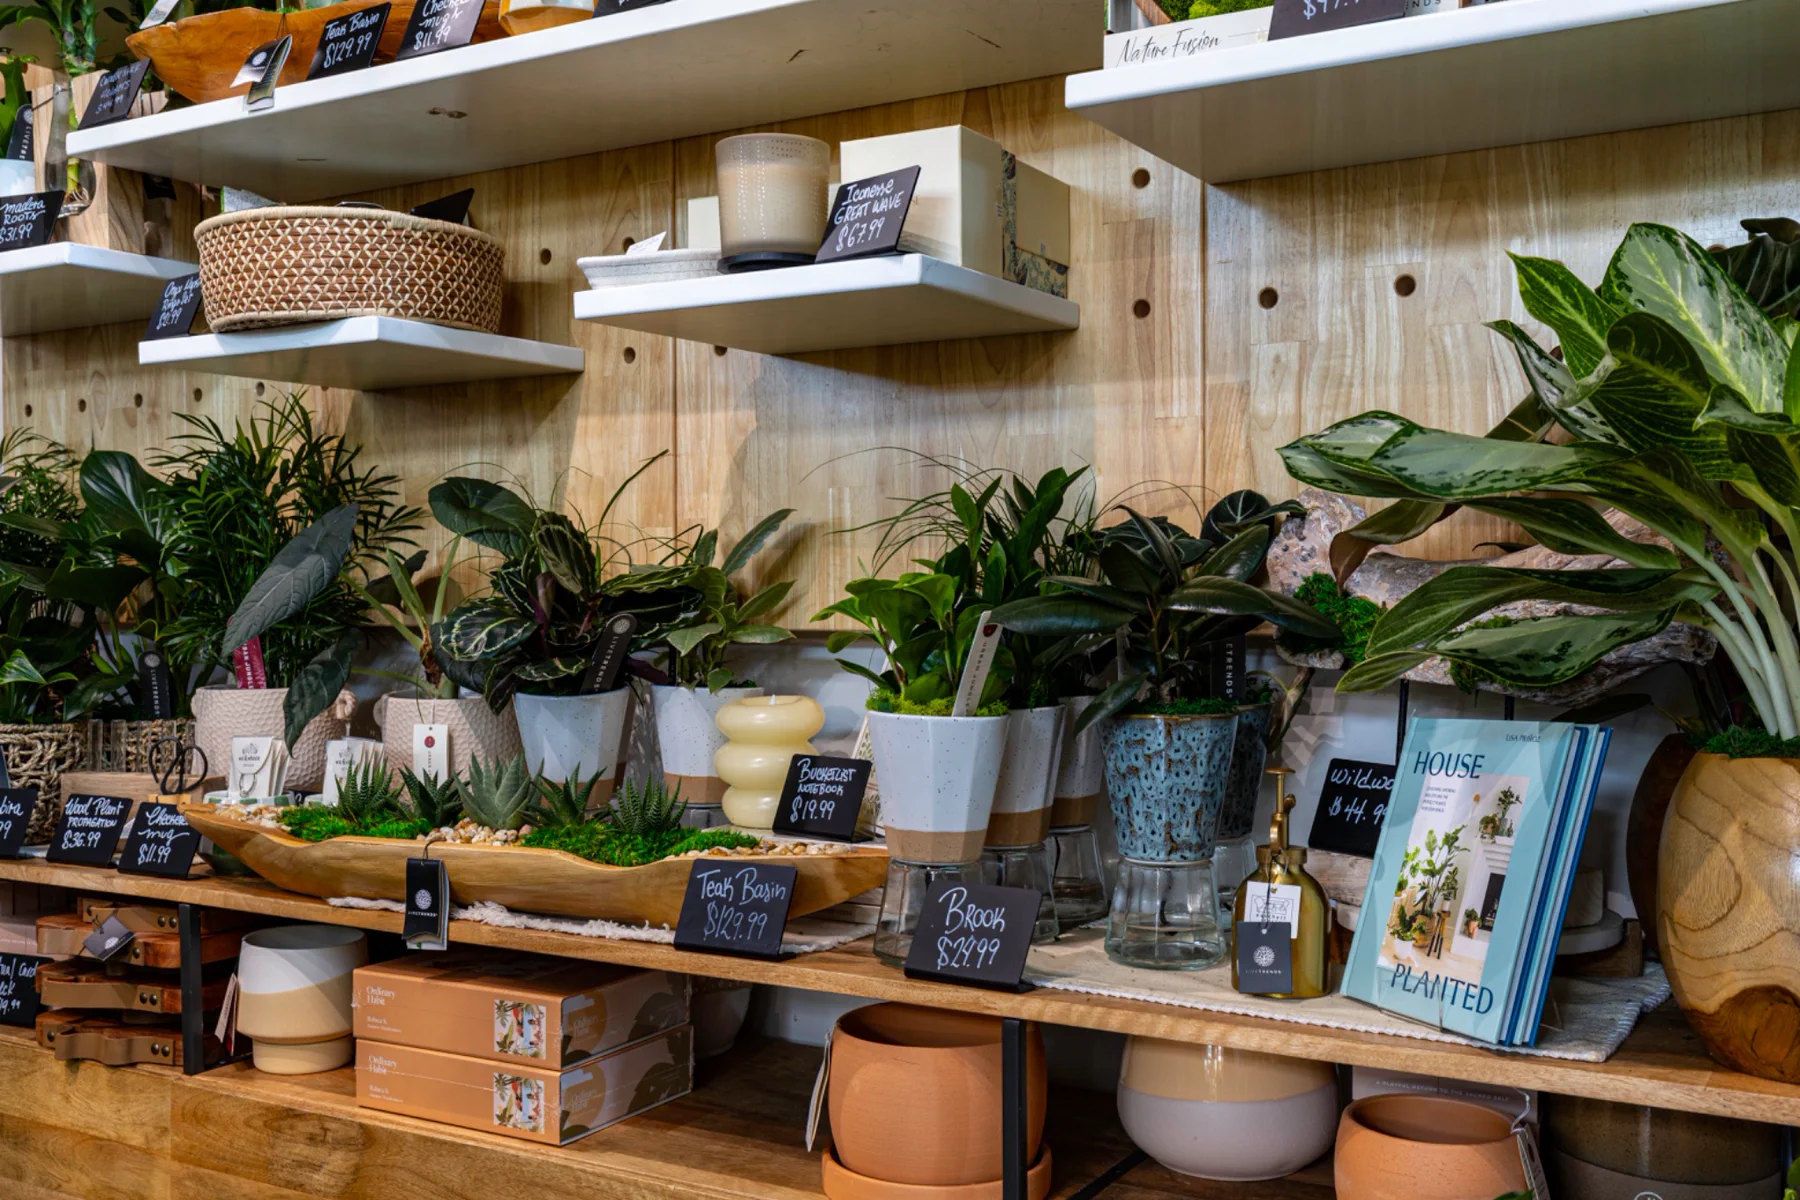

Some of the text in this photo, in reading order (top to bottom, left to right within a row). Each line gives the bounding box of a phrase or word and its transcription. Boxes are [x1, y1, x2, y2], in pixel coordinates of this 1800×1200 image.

[325, 12, 380, 40] Teak Basin
[413, 25, 451, 50] $11.99
[324, 32, 372, 68] $129.99
[1116, 27, 1221, 67] Nature Fusion
[841, 178, 894, 206] Iconesse
[834, 202, 871, 225] GREAT
[872, 191, 904, 213] WAVE
[0, 222, 33, 244] $31.99
[836, 217, 885, 252] $67.99
[1506, 733, 1519, 742] LISA
[1413, 751, 1485, 779] HOUSE
[65, 797, 124, 815] Wood Plant
[790, 795, 835, 823] $19.99
[62, 830, 101, 849] $36.99
[138, 829, 190, 846] mug
[138, 843, 171, 865] $11.99
[697, 867, 786, 905] Teak Basin
[703, 900, 767, 941] $129.99
[937, 935, 1000, 970] $24.99
[1390, 963, 1494, 1015] PLANTED
